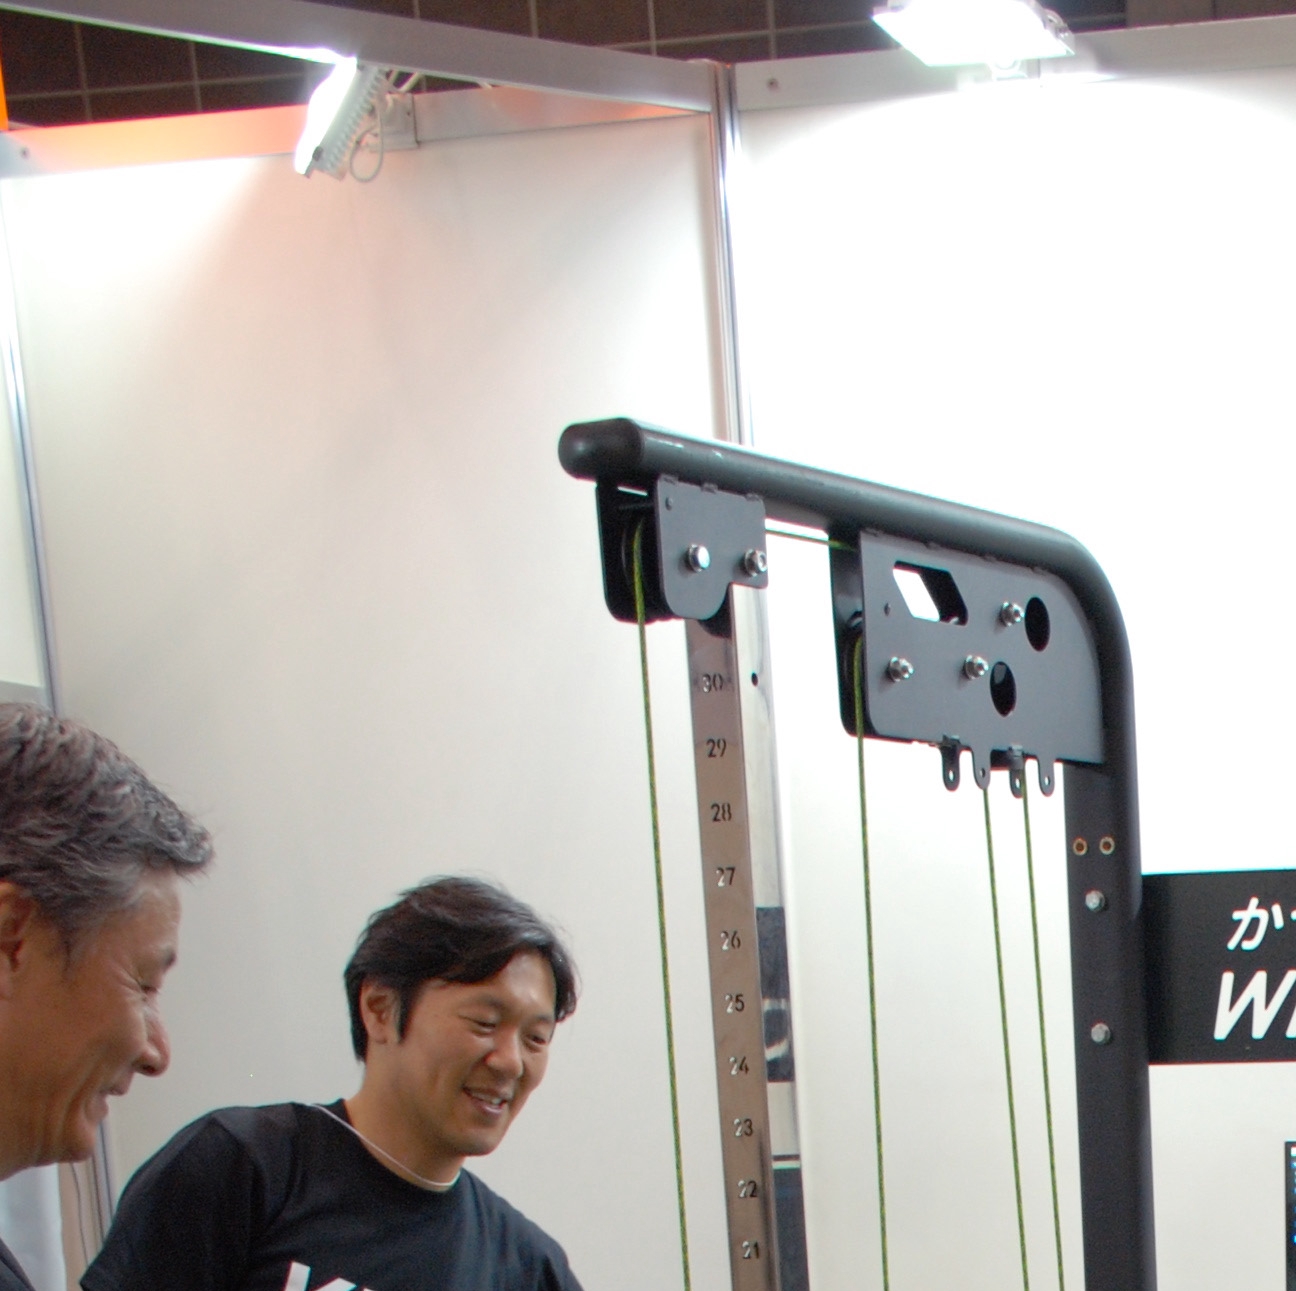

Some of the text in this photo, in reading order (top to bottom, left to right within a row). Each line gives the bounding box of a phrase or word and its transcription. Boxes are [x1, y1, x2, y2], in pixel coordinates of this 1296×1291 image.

[702, 674, 723, 693] 30
[706, 738, 726, 758] 29
[711, 803, 732, 822] 28
[716, 866, 736, 887] 27
[720, 930, 741, 950] 26
[725, 993, 745, 1013] 25
[729, 1056, 749, 1076] 24
[733, 1118, 753, 1137] 23
[737, 1180, 757, 1198] 22
[742, 1241, 760, 1259] 21
